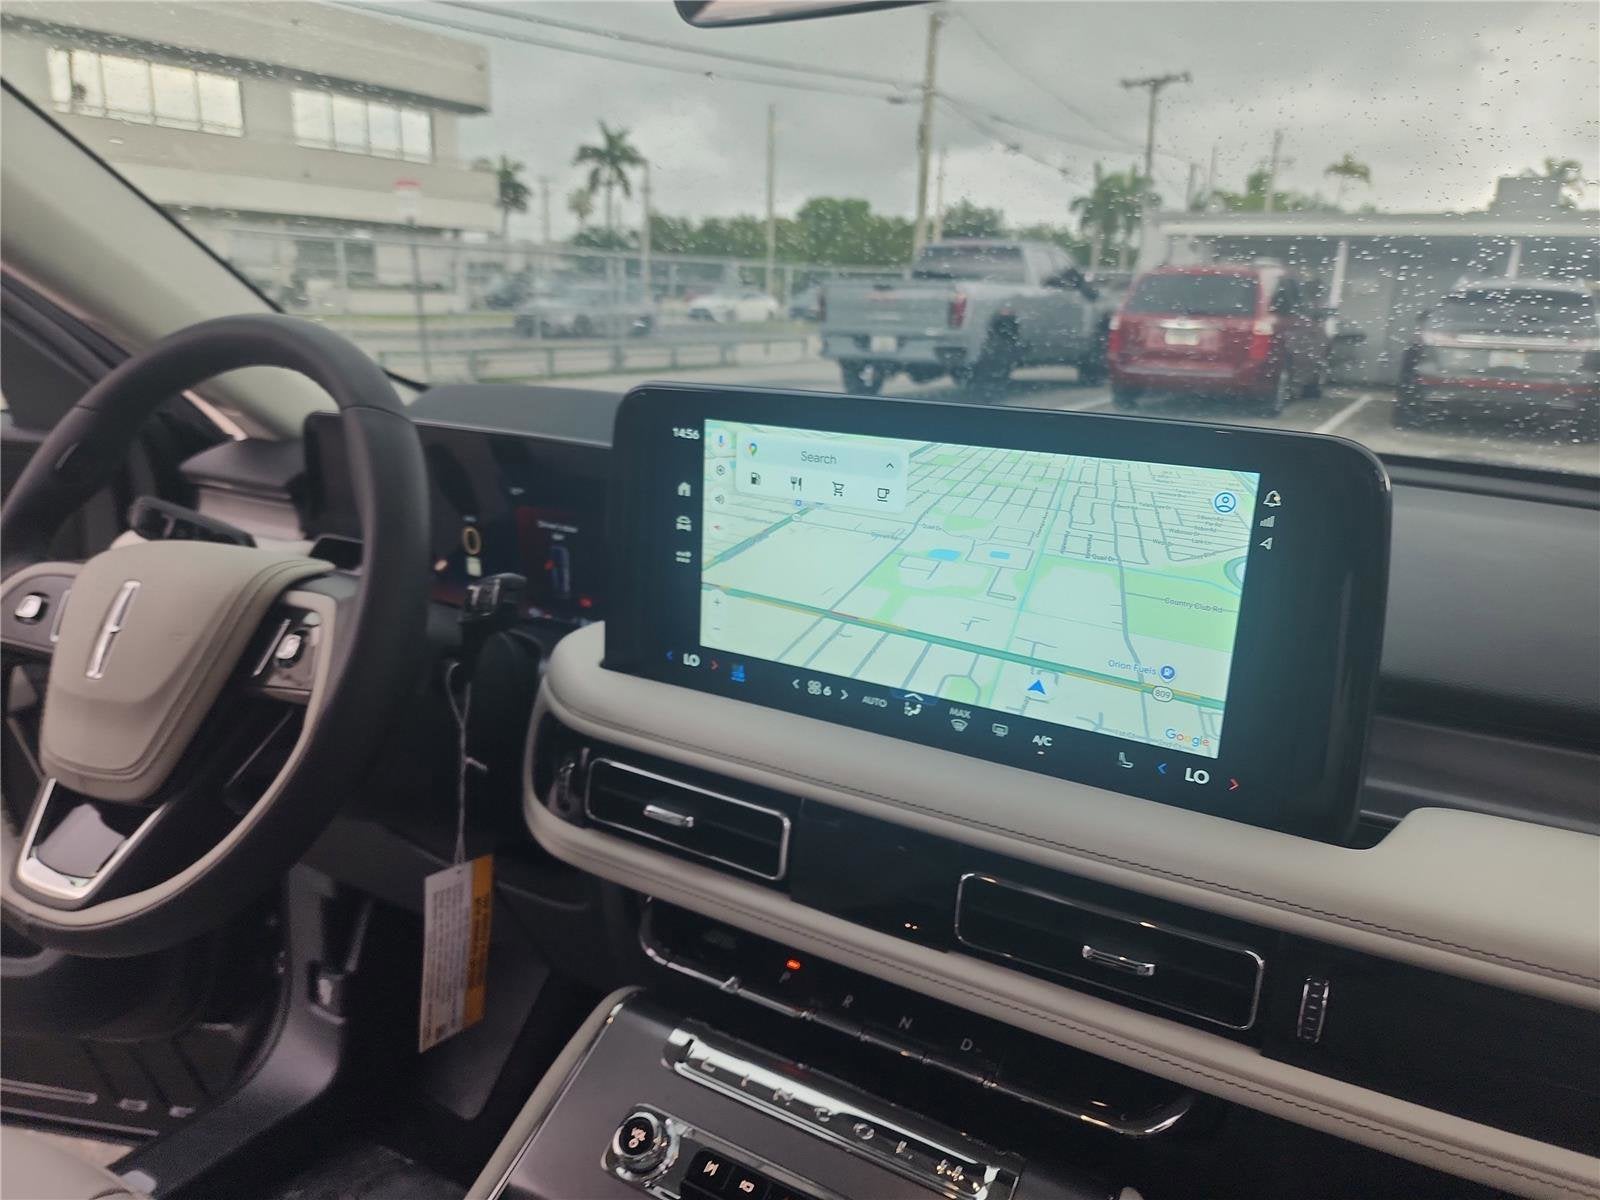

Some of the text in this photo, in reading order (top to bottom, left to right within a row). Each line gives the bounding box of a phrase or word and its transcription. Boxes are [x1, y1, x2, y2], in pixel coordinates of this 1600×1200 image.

[800, 450, 837, 466] Search
[1164, 597, 1223, 613] Country Club Rd
[683, 653, 700, 667] LO
[1108, 659, 1157, 675] Orion Fuels
[823, 686, 832, 696] 6
[1154, 689, 1171, 699] 809
[862, 695, 888, 708] AUTO
[949, 707, 971, 719] MAX
[1032, 735, 1053, 747] A/C
[1165, 728, 1210, 748] Google
[1184, 767, 1210, 785] LO
[842, 994, 854, 1008] R
[899, 1017, 913, 1029] N
[960, 1038, 974, 1051] D
